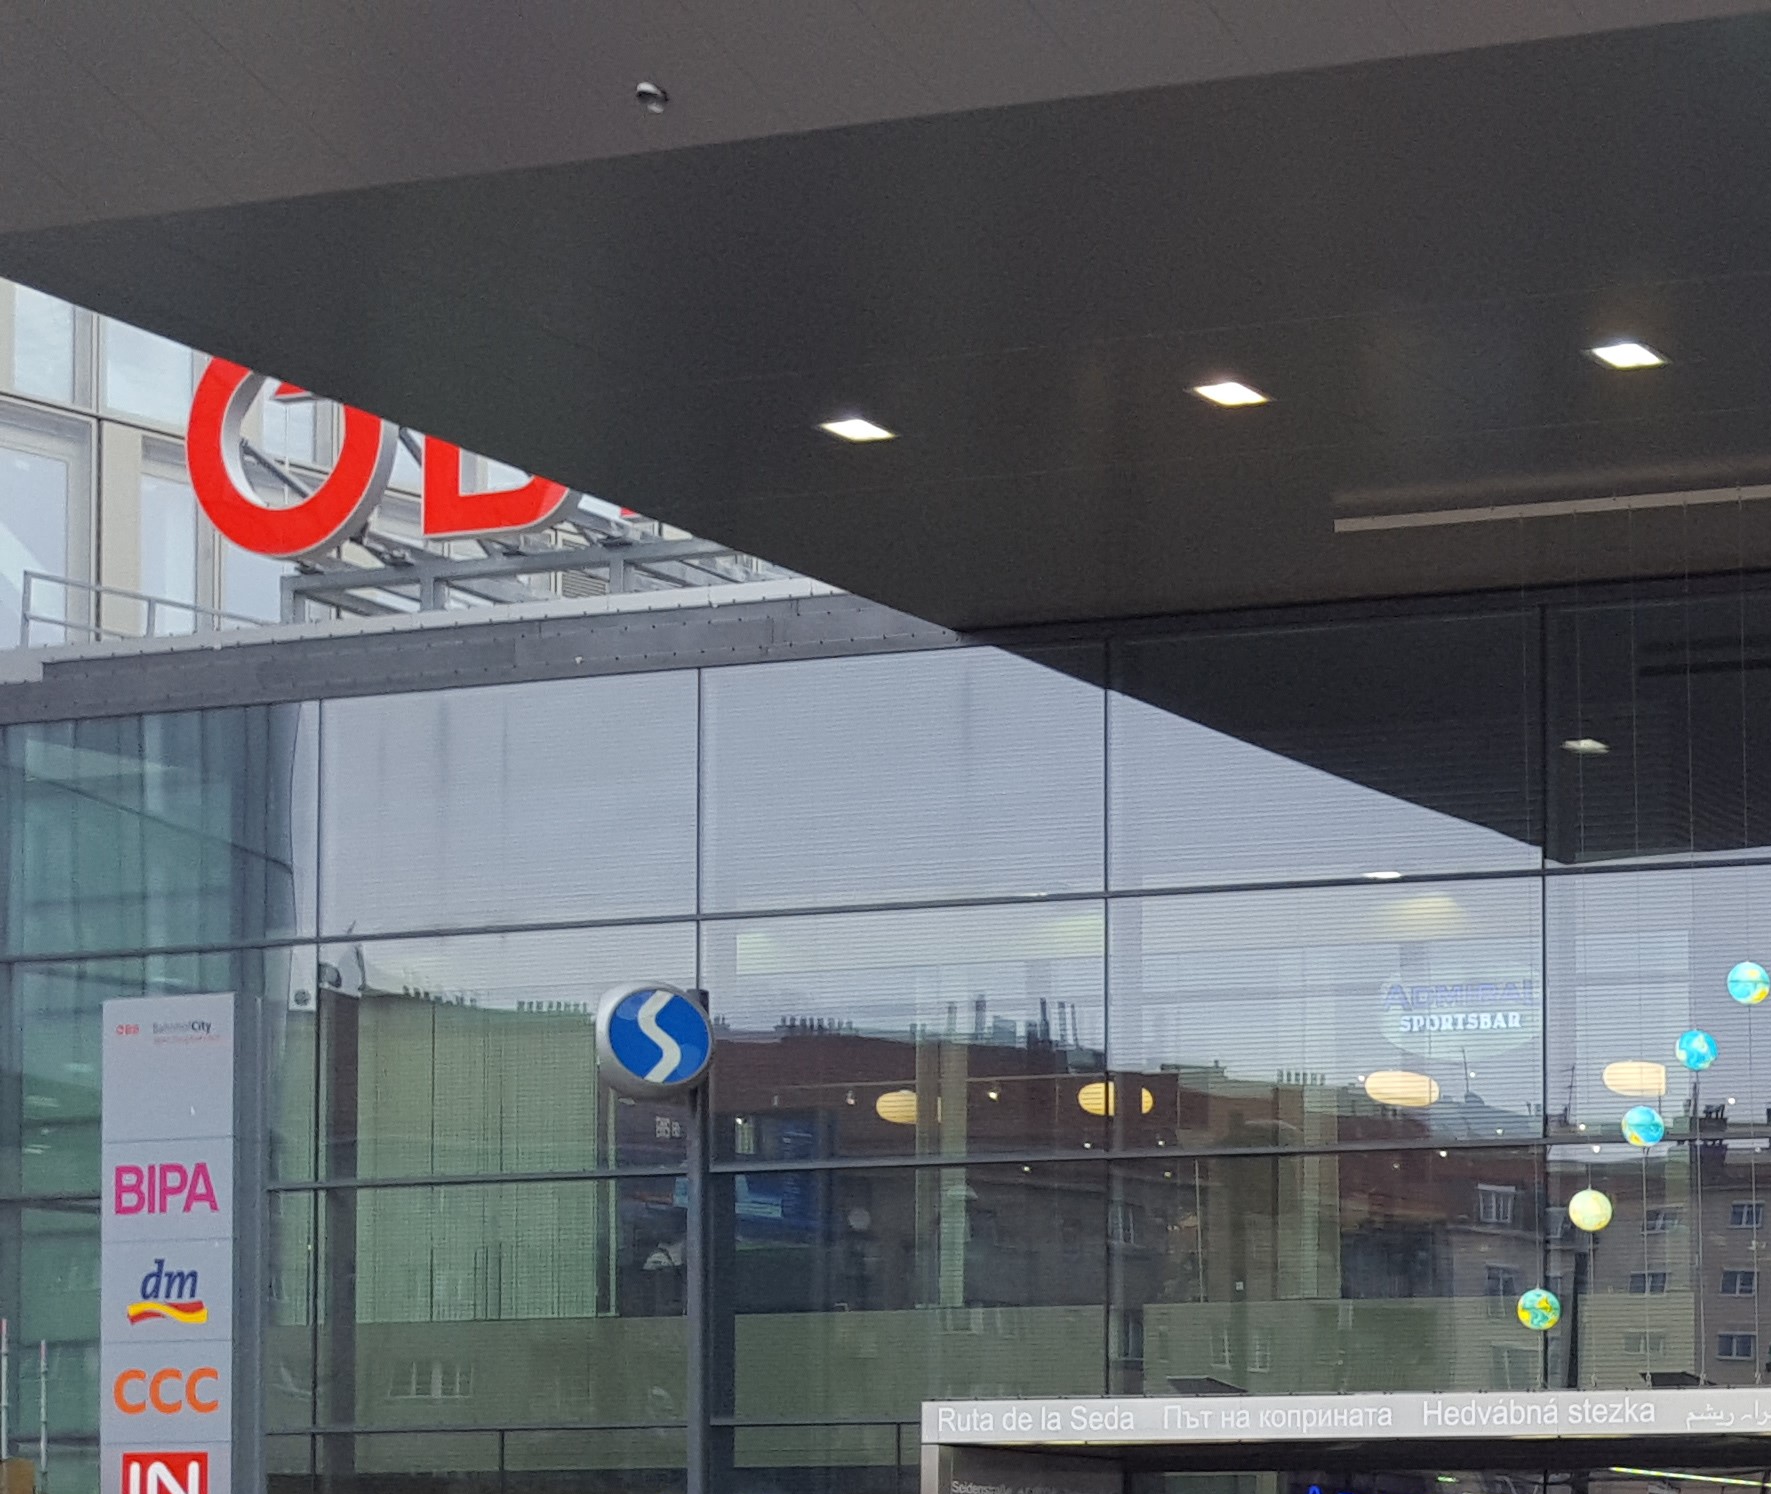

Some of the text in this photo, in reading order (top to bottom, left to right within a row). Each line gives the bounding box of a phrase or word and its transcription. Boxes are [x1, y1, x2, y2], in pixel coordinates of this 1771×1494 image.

[1400, 1012, 1522, 1032] SPORTSBAR
[114, 1162, 220, 1215] BIPA
[141, 1258, 198, 1300] dm
[113, 1366, 219, 1415] CCC
[938, 1405, 1134, 1432] Ruta de la Seda
[1163, 1405, 1392, 1434] Път на коприната
[1423, 1397, 1655, 1427] Hedvábná stezka
